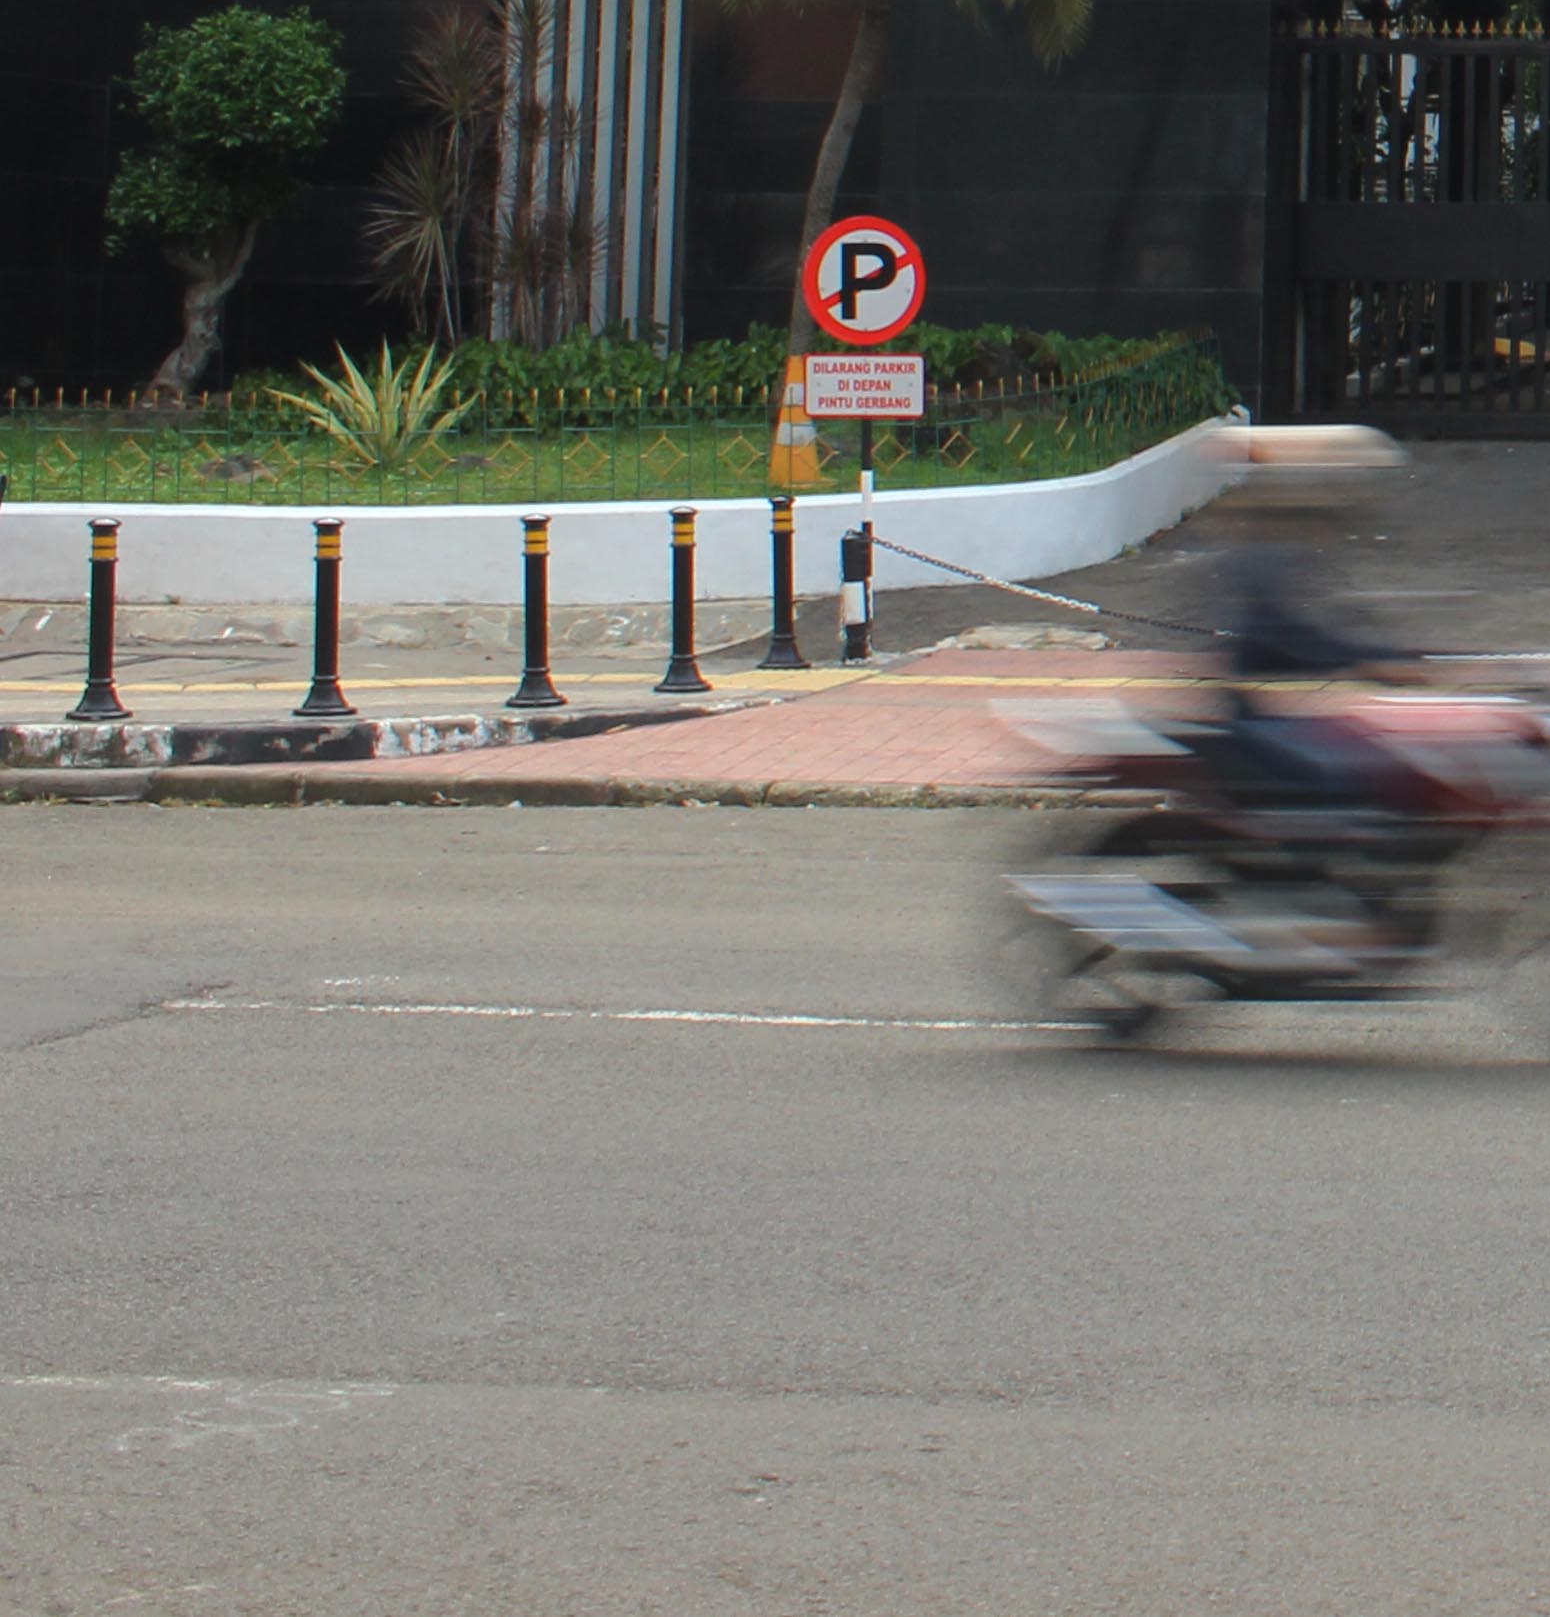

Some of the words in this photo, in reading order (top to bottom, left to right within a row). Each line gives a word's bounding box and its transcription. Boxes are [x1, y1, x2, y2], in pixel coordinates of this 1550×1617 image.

[840, 243, 897, 319] P
[813, 362, 870, 374] DILARANG
[874, 362, 916, 374] PARKIR
[838, 379, 850, 392] DI
[853, 379, 891, 392] DEPAN
[818, 397, 853, 408] PINTU
[855, 397, 911, 409] GERBANG
